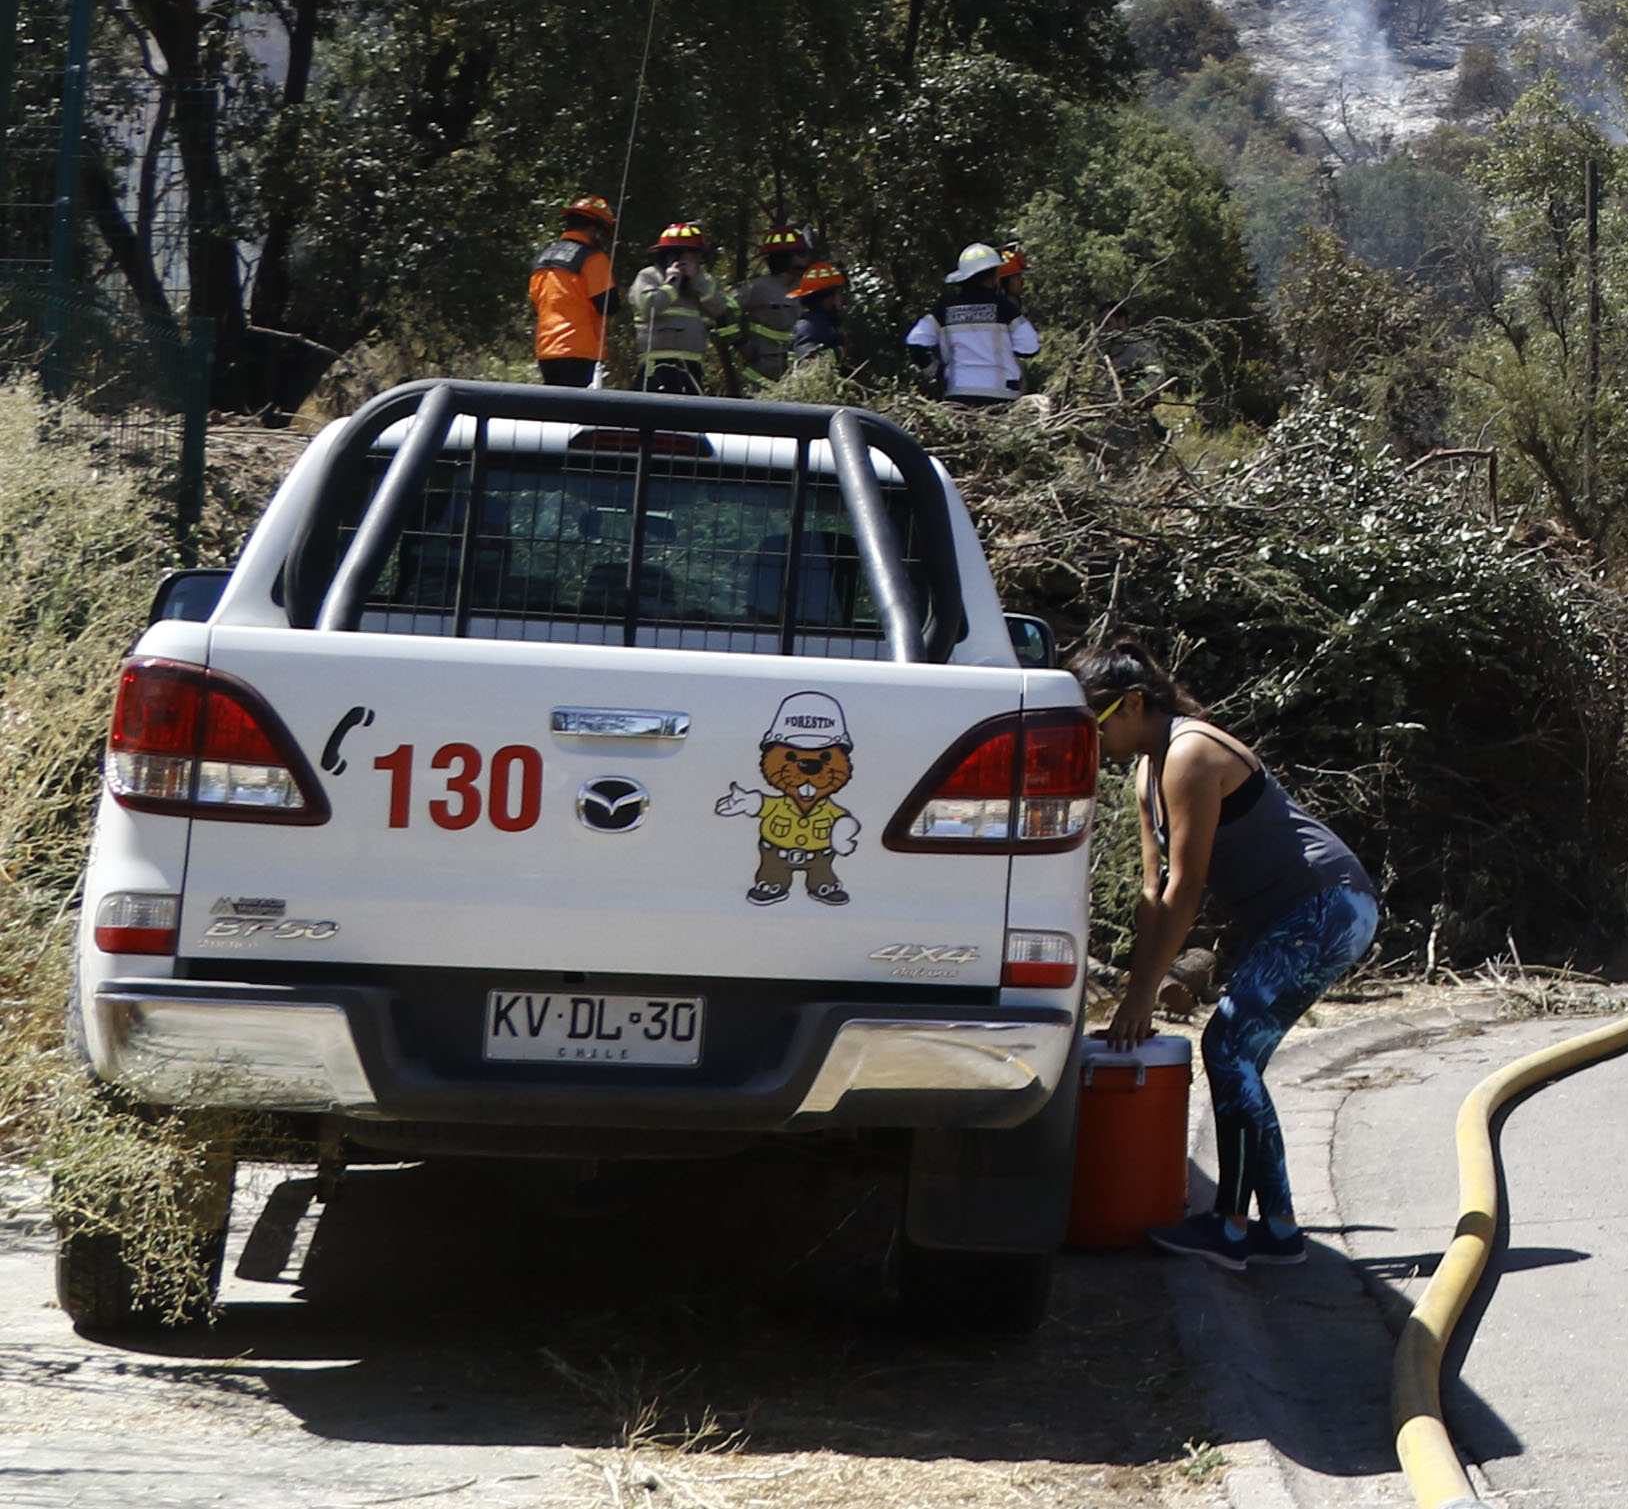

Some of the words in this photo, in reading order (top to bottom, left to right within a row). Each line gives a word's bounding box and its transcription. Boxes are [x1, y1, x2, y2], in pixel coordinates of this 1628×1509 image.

[784, 714, 836, 730] FORESTIN
[373, 742, 544, 833] 130
[205, 916, 340, 940] BT-50
[557, 1046, 630, 1061] CHILE
